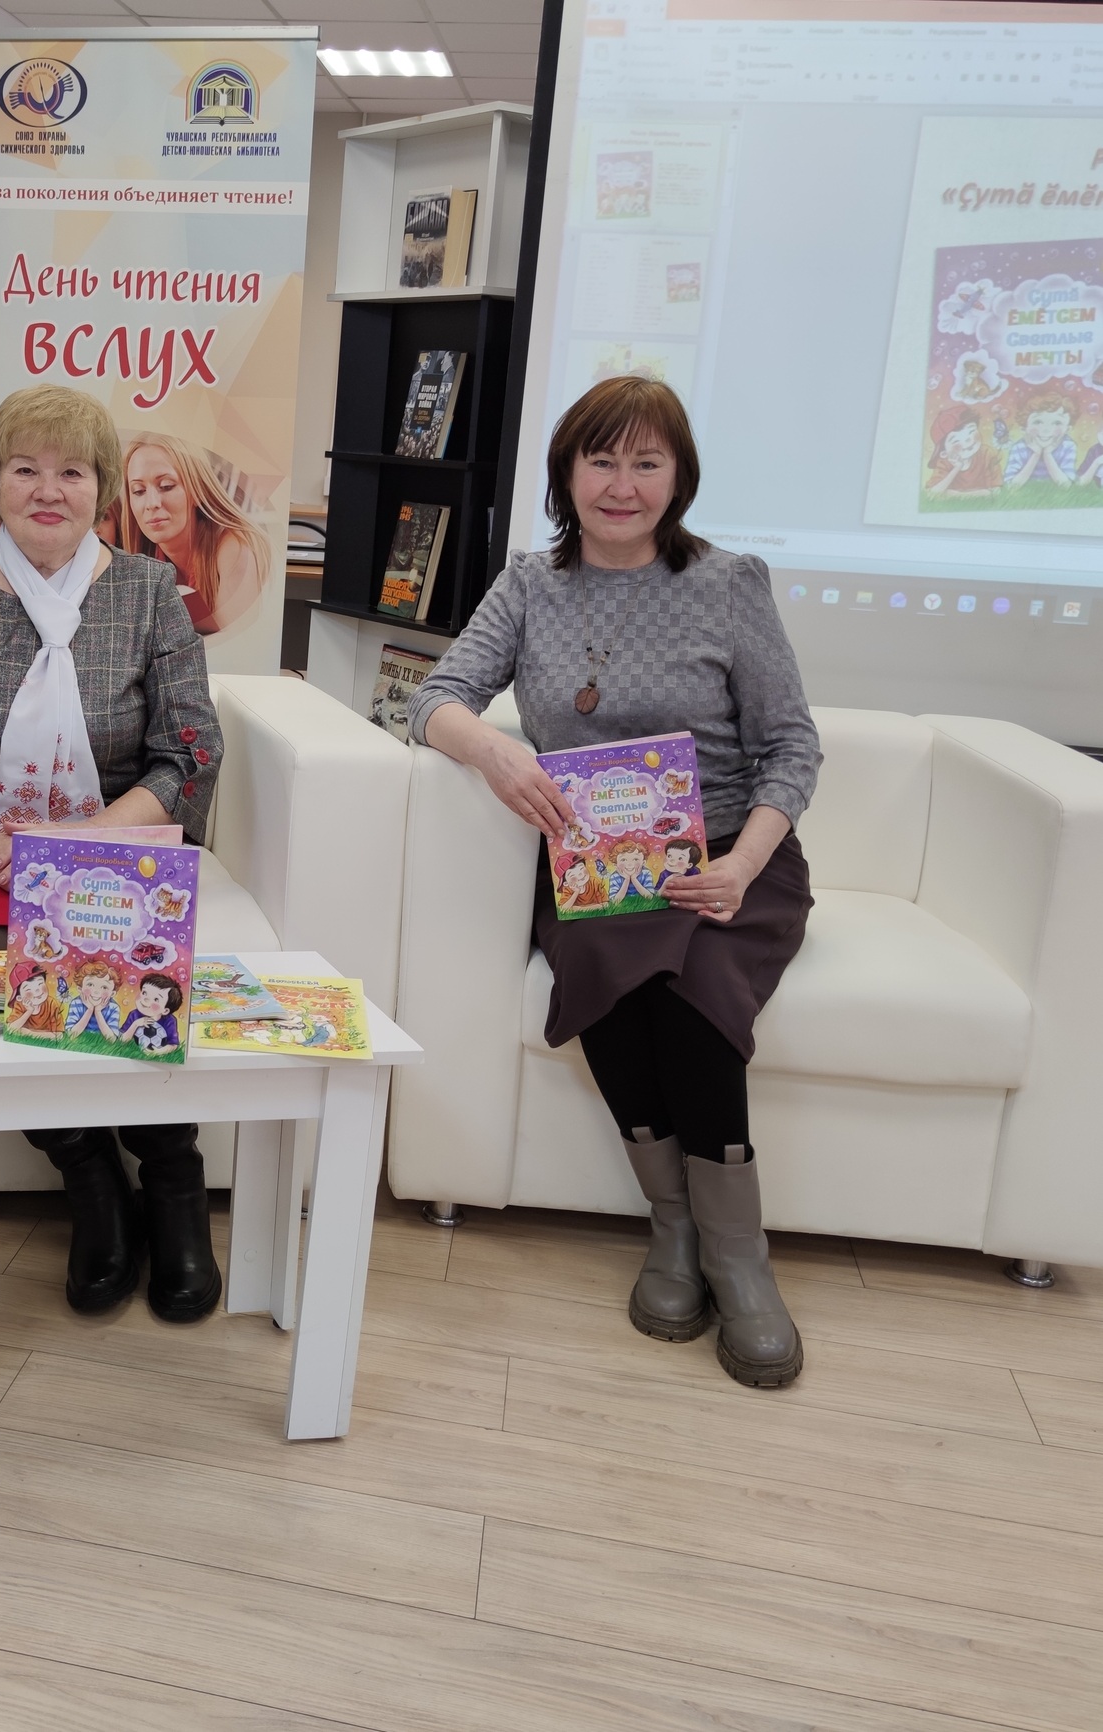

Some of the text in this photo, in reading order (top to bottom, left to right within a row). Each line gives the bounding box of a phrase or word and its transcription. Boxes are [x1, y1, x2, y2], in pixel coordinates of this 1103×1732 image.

[15, 131, 66, 142] СОЮЗ ОХРАНЫ
[166, 132, 277, 143] ЧУВАШСКАЯ РЕСПУБЛИКАНСКАЯ
[50, 145, 85, 155] ЗДОРОВЬЯ
[162, 145, 280, 157] ДЕТСКО-ЮНОШЕСКАЯ БИБЛИОТЕКА
[16, 186, 109, 201] поколения
[114, 187, 219, 205] объединяет
[224, 190, 293, 206] чтение!
[4, 253, 261, 304] День чтения
[1006, 331, 1094, 347] Светлые
[1015, 350, 1083, 367] МЕЧТЫ
[24, 322, 217, 409] вслух
[418, 400, 432, 408] ВОЙНА
[751, 534, 787, 548] слайду
[384, 578, 411, 591] ГОВОРЯТ
[380, 595, 401, 608] ГЕРОИ
[382, 587, 417, 603] ПОГИБШИЕ
[380, 660, 401, 676] ВОЙНЫ
[593, 802, 648, 814] Светлые
[601, 813, 644, 826] МЕЧТЫ
[72, 855, 133, 866] Раиса Воробьева
[66, 910, 132, 926] Светлые
[73, 927, 123, 941] МЕЧТЫ
